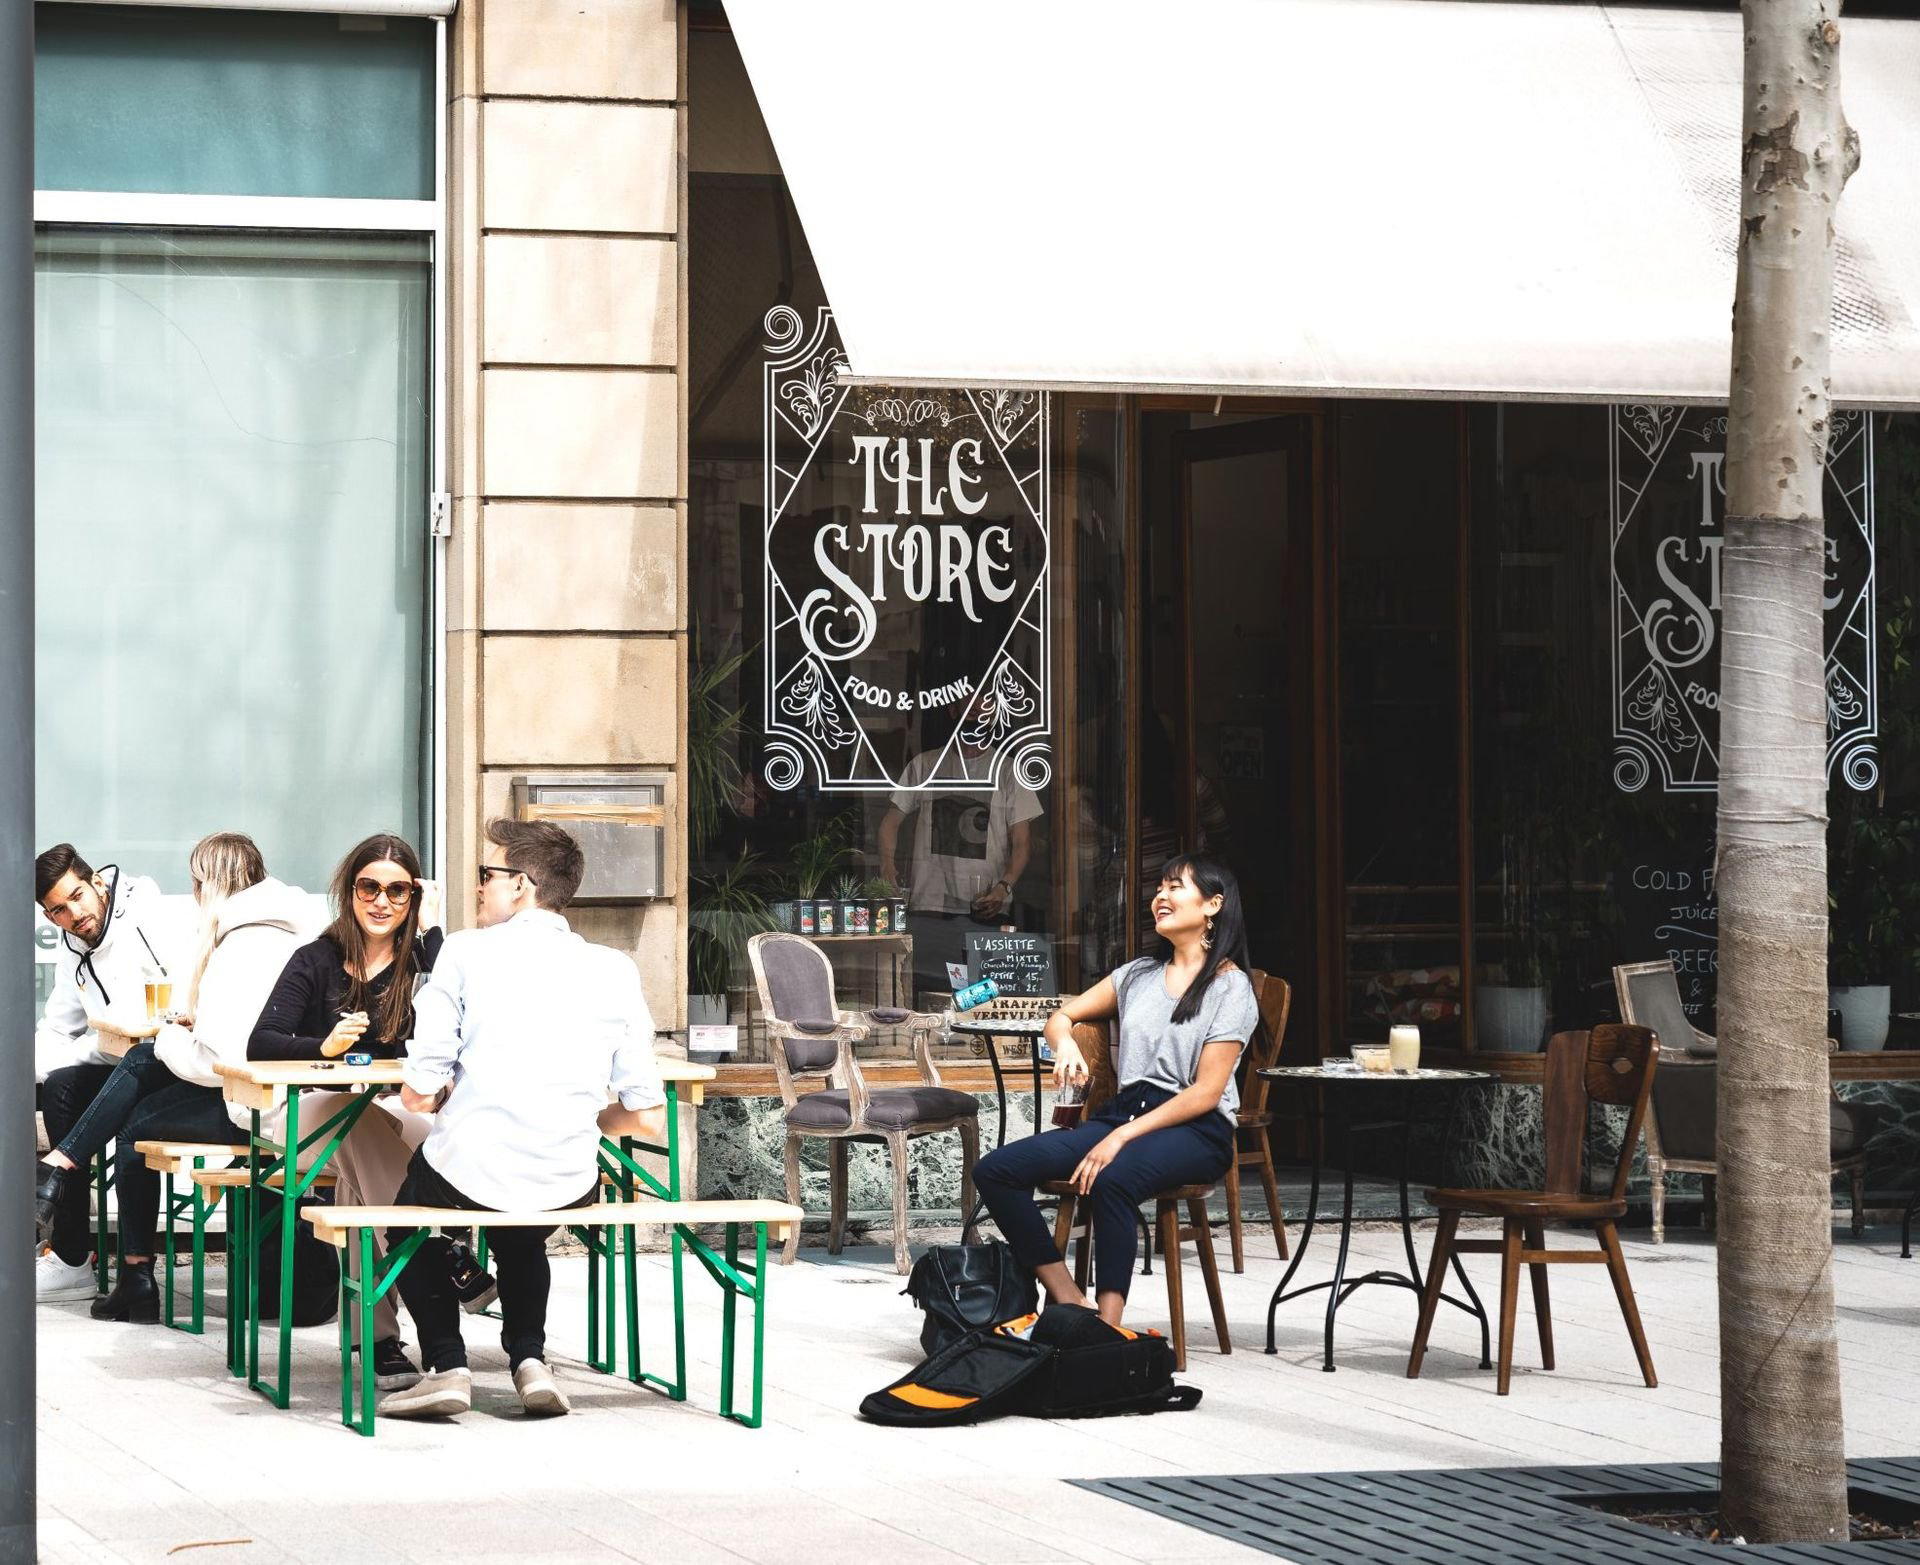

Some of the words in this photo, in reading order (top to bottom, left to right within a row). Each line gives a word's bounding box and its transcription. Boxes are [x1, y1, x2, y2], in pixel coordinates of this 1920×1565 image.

[849, 435, 988, 516] THE
[799, 523, 1017, 661] STORE
[842, 674, 891, 708] FOOD
[896, 687, 915, 711] &
[918, 674, 976, 710] DRINK
[1685, 681, 1721, 712] FOO
[1632, 864, 1692, 891] COLD
[1691, 978, 1703, 997] &
